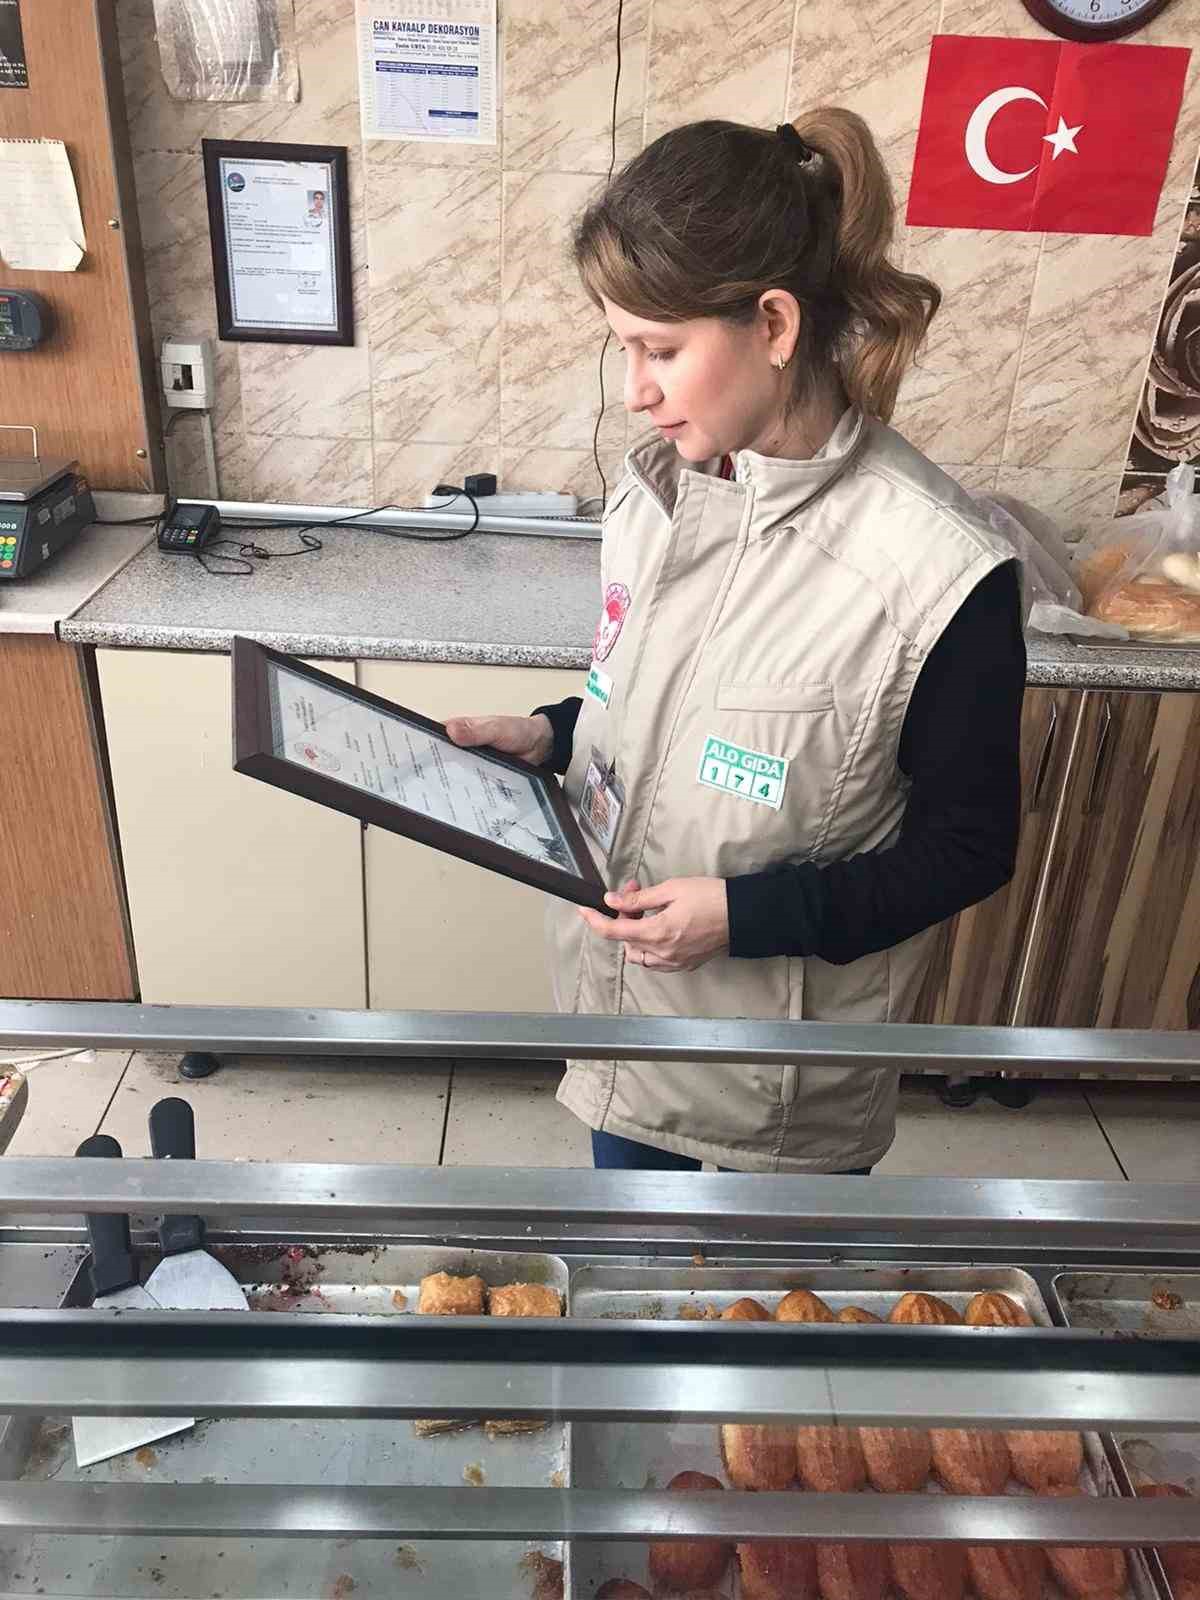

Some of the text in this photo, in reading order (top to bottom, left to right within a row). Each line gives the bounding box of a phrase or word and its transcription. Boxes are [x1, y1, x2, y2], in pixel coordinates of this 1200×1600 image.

[1090, 0, 1100, 12] 6
[373, 20, 480, 36] CAN KAYAALP DEKORASYON
[708, 742, 782, 778] ALO GIDA
[758, 783, 770, 797] 4
